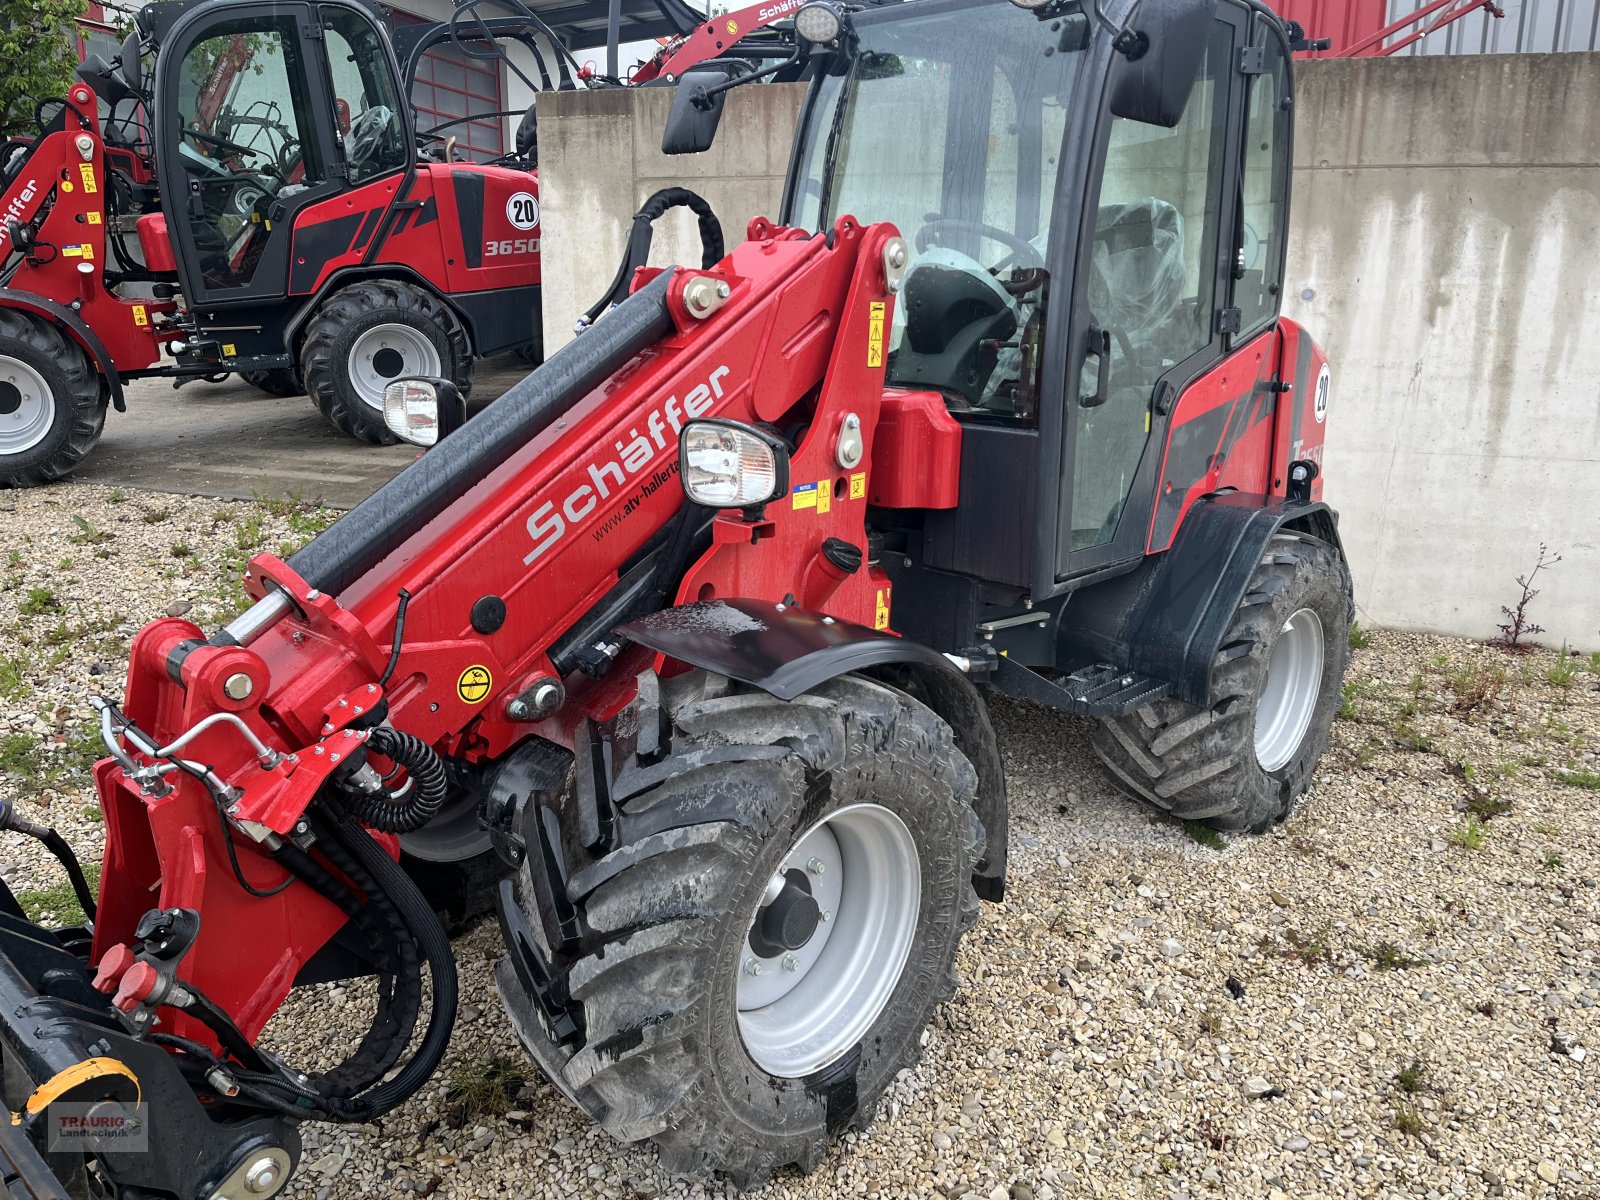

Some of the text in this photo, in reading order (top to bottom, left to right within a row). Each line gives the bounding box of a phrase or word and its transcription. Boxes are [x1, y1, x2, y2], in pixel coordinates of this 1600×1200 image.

[513, 199, 535, 223] 20
[484, 238, 541, 256] 3650
[1317, 374, 1329, 411] 20
[522, 364, 730, 567] Schäffer
